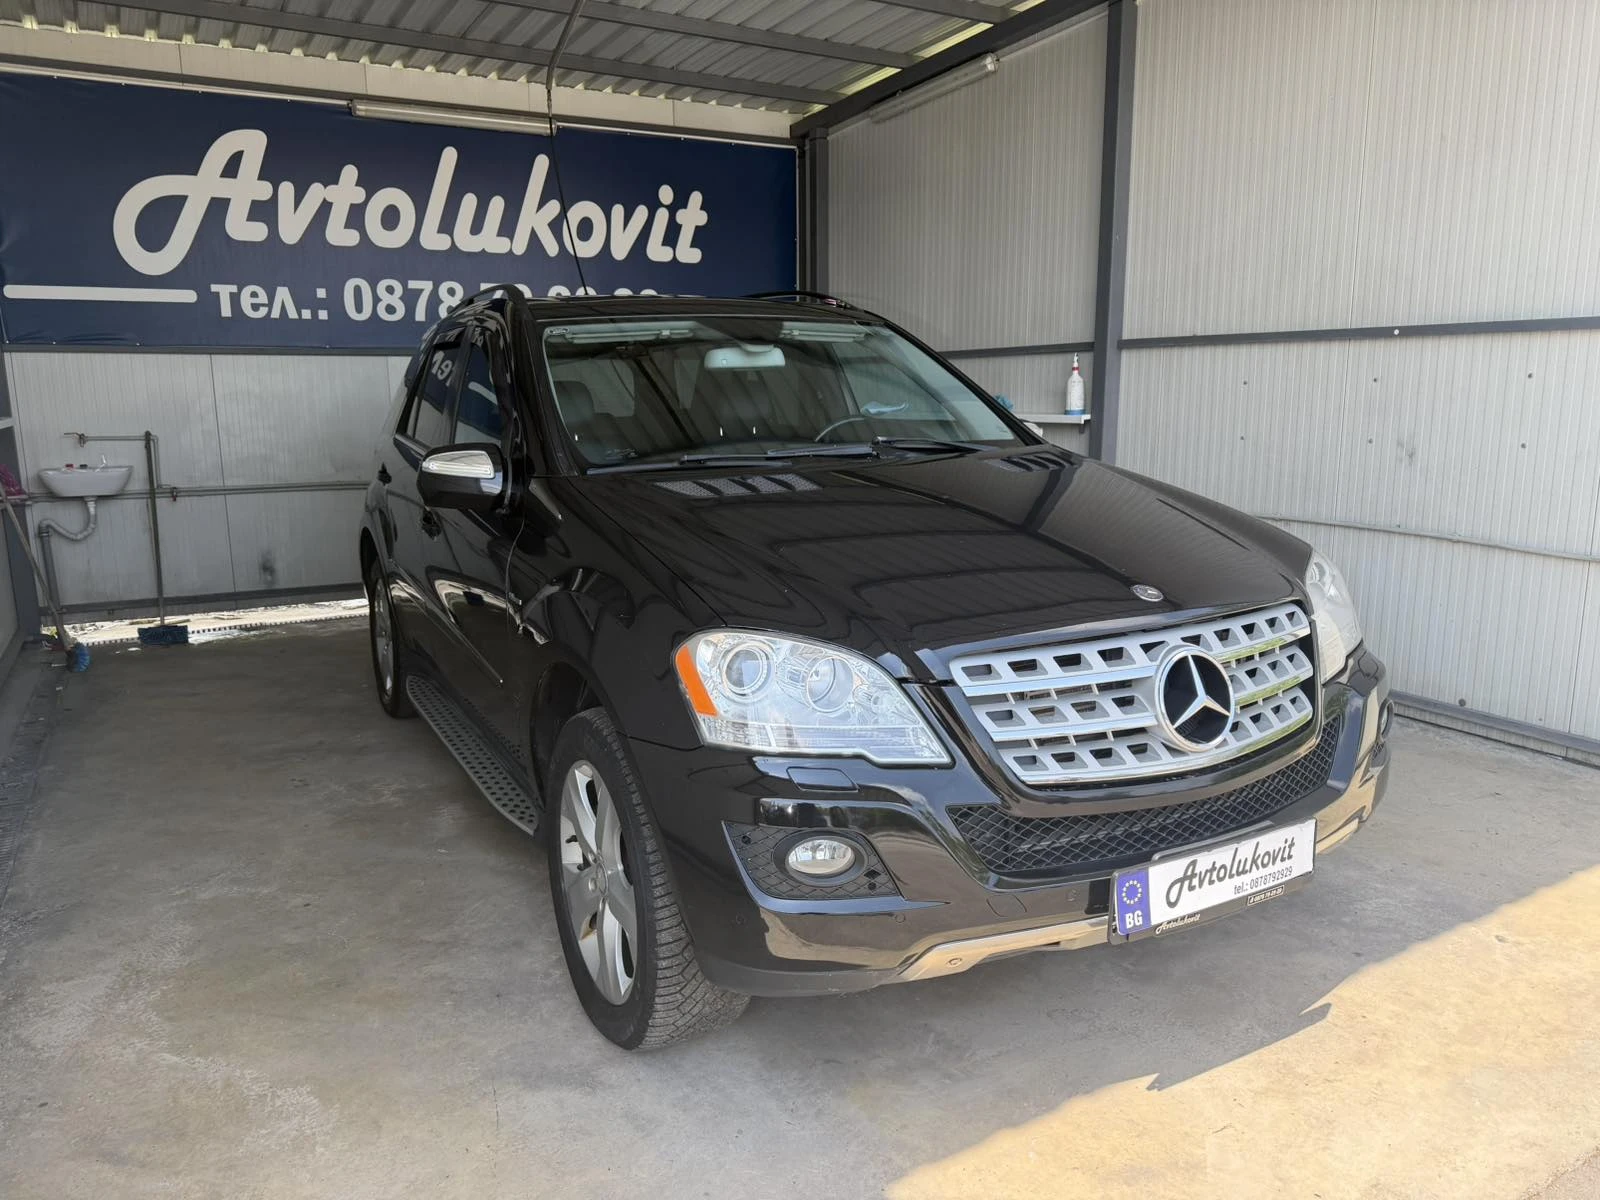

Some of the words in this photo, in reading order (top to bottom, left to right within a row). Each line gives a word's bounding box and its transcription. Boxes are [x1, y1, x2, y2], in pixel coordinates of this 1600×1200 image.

[113, 129, 708, 276] Avtolukovit
[210, 284, 328, 320] тел.:
[344, 277, 464, 321] 0878
[1166, 837, 1295, 908] Avtolukovit
[1250, 866, 1293, 889] 0878792929
[1125, 910, 1143, 929] BG
